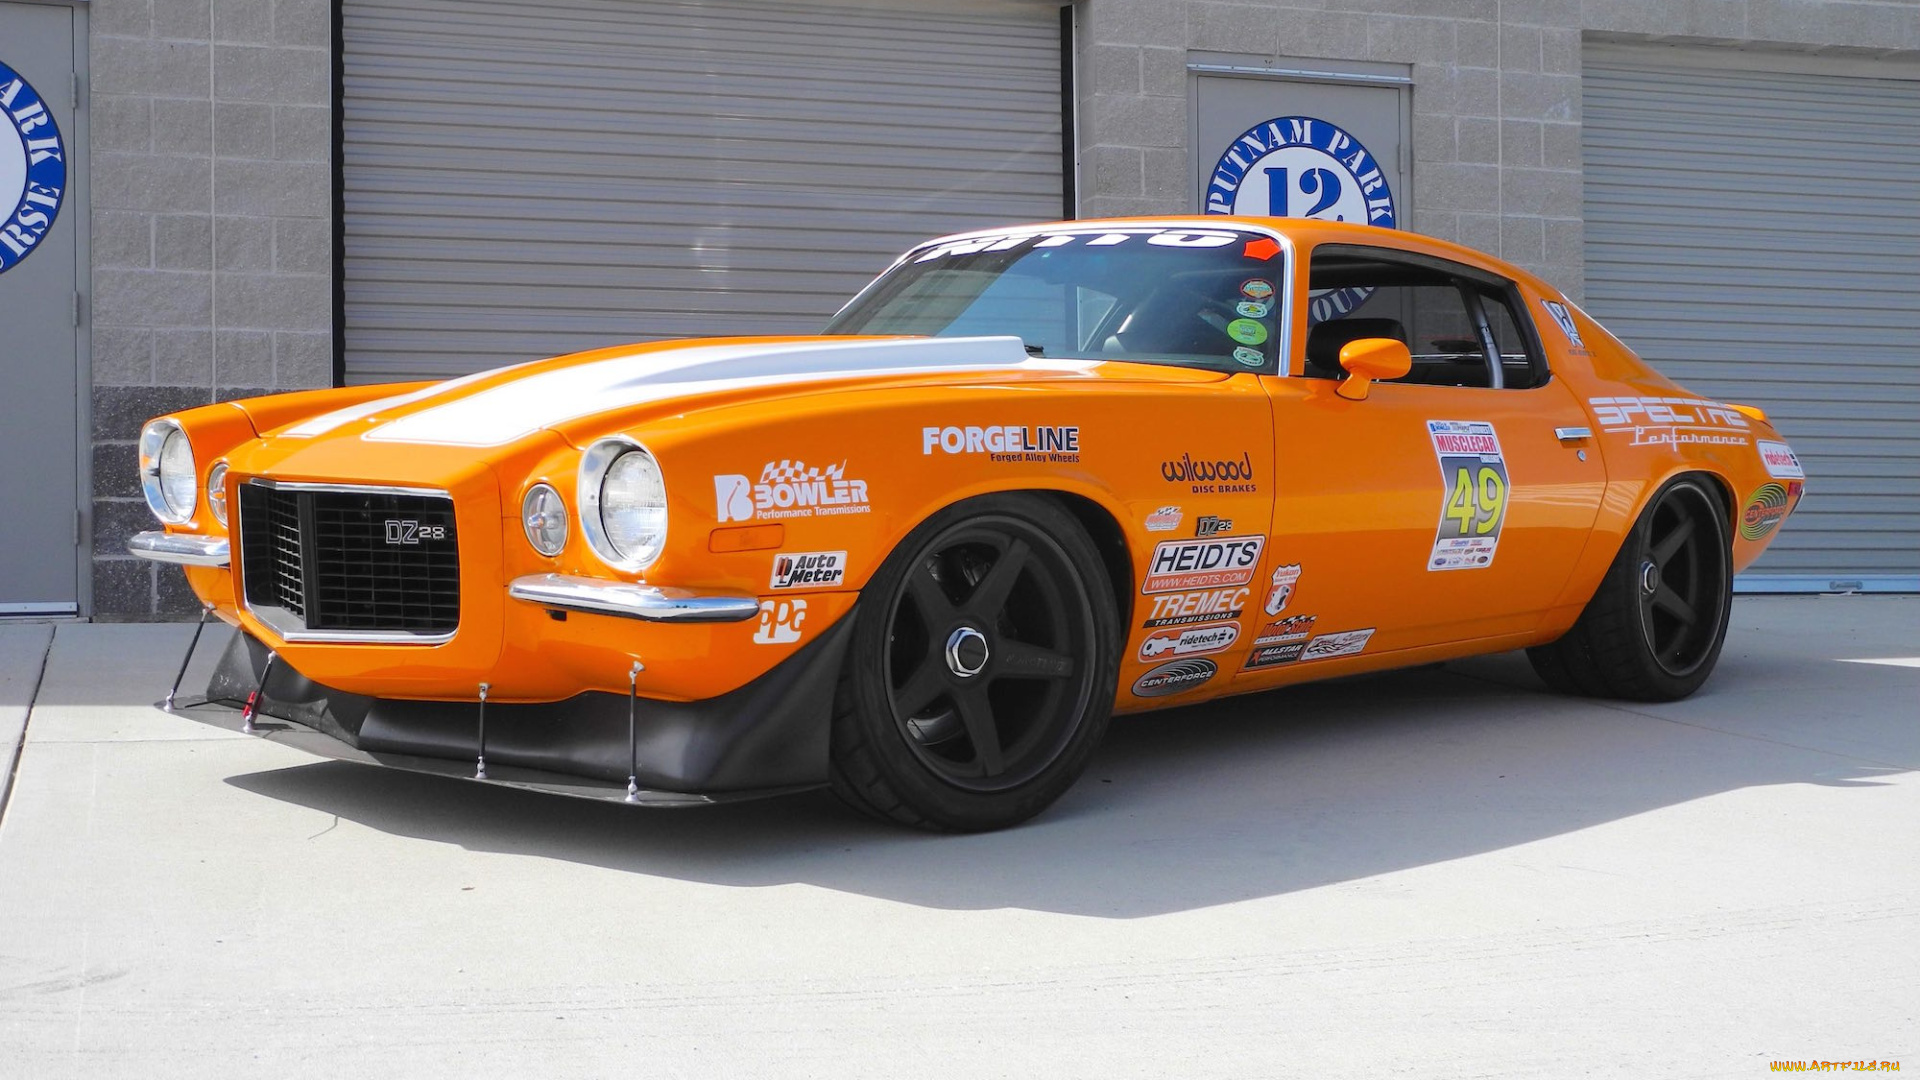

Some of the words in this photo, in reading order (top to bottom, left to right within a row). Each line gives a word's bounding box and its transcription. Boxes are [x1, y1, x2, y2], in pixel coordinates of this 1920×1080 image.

[1208, 119, 1312, 214] PUTNAM
[1326, 129, 1393, 221] PARK
[1263, 167, 1343, 221] 12
[0, 181, 60, 270] RSE
[923, 426, 1079, 455] FORGELINE
[1436, 435, 1497, 452] MUSCLECAR
[1630, 425, 1748, 452] Performance
[990, 453, 1022, 463] Forged
[1025, 453, 1047, 463] Alloy
[1049, 453, 1080, 463] Wheels
[1161, 451, 1252, 482] wilwood
[754, 480, 869, 509] BOWLER
[1192, 485, 1215, 494] DISC
[1218, 484, 1257, 493] BRAKES
[1446, 467, 1505, 534] 49
[757, 508, 812, 520] Performance
[815, 504, 871, 517] Transmissions
[385, 520, 445, 545] DZ28
[795, 555, 836, 570] Auto
[1154, 542, 1258, 573] HEIDTS
[790, 568, 842, 585] Meter
[1151, 572, 1247, 589] WWW.HEIDTS.COM
[1150, 588, 1250, 620] TREMEC
[1155, 612, 1234, 626] TRANSMISSIONS
[1180, 632, 1218, 646] ridetech
[1260, 644, 1304, 656] ALLSTAR
[1141, 670, 1214, 687] CENTERFORCE
